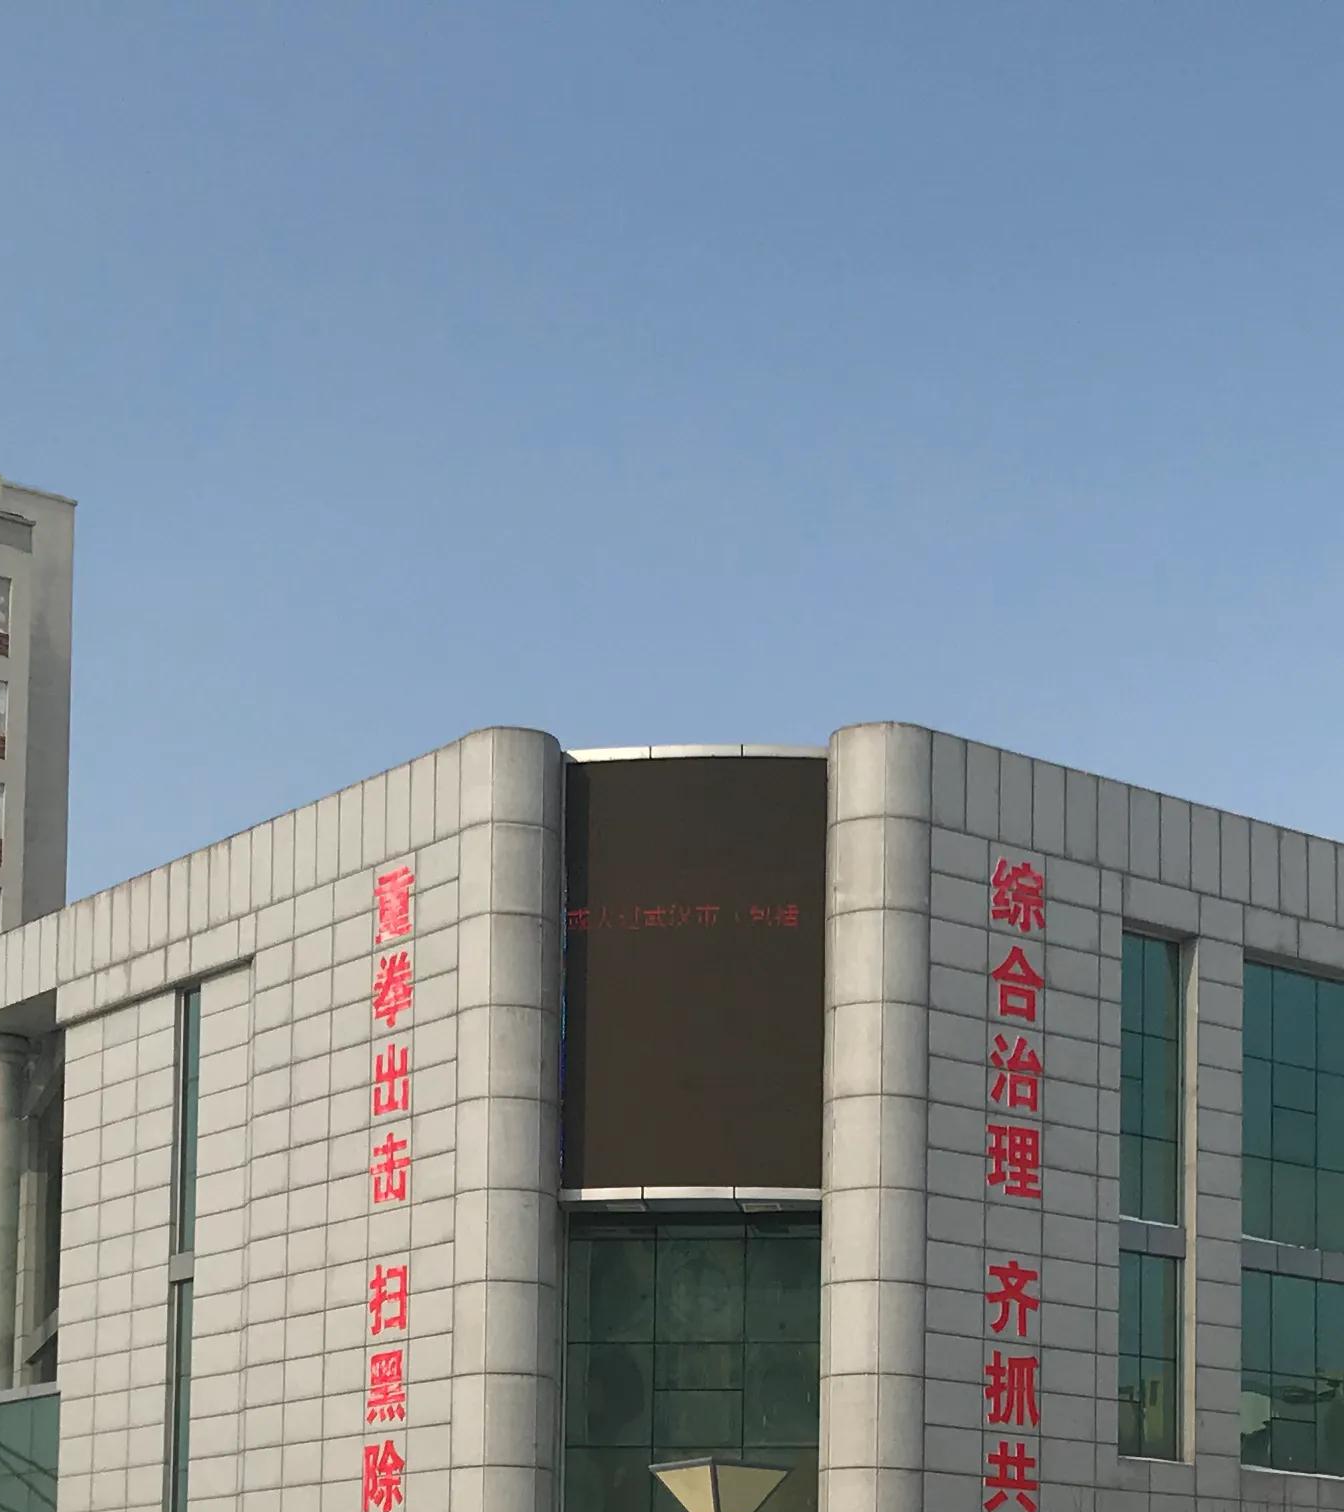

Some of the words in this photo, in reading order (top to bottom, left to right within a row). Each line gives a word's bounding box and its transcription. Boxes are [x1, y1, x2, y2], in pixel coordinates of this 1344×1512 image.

[369, 865, 415, 1204] 重拳出击
[985, 855, 1046, 1200] 综合治理
